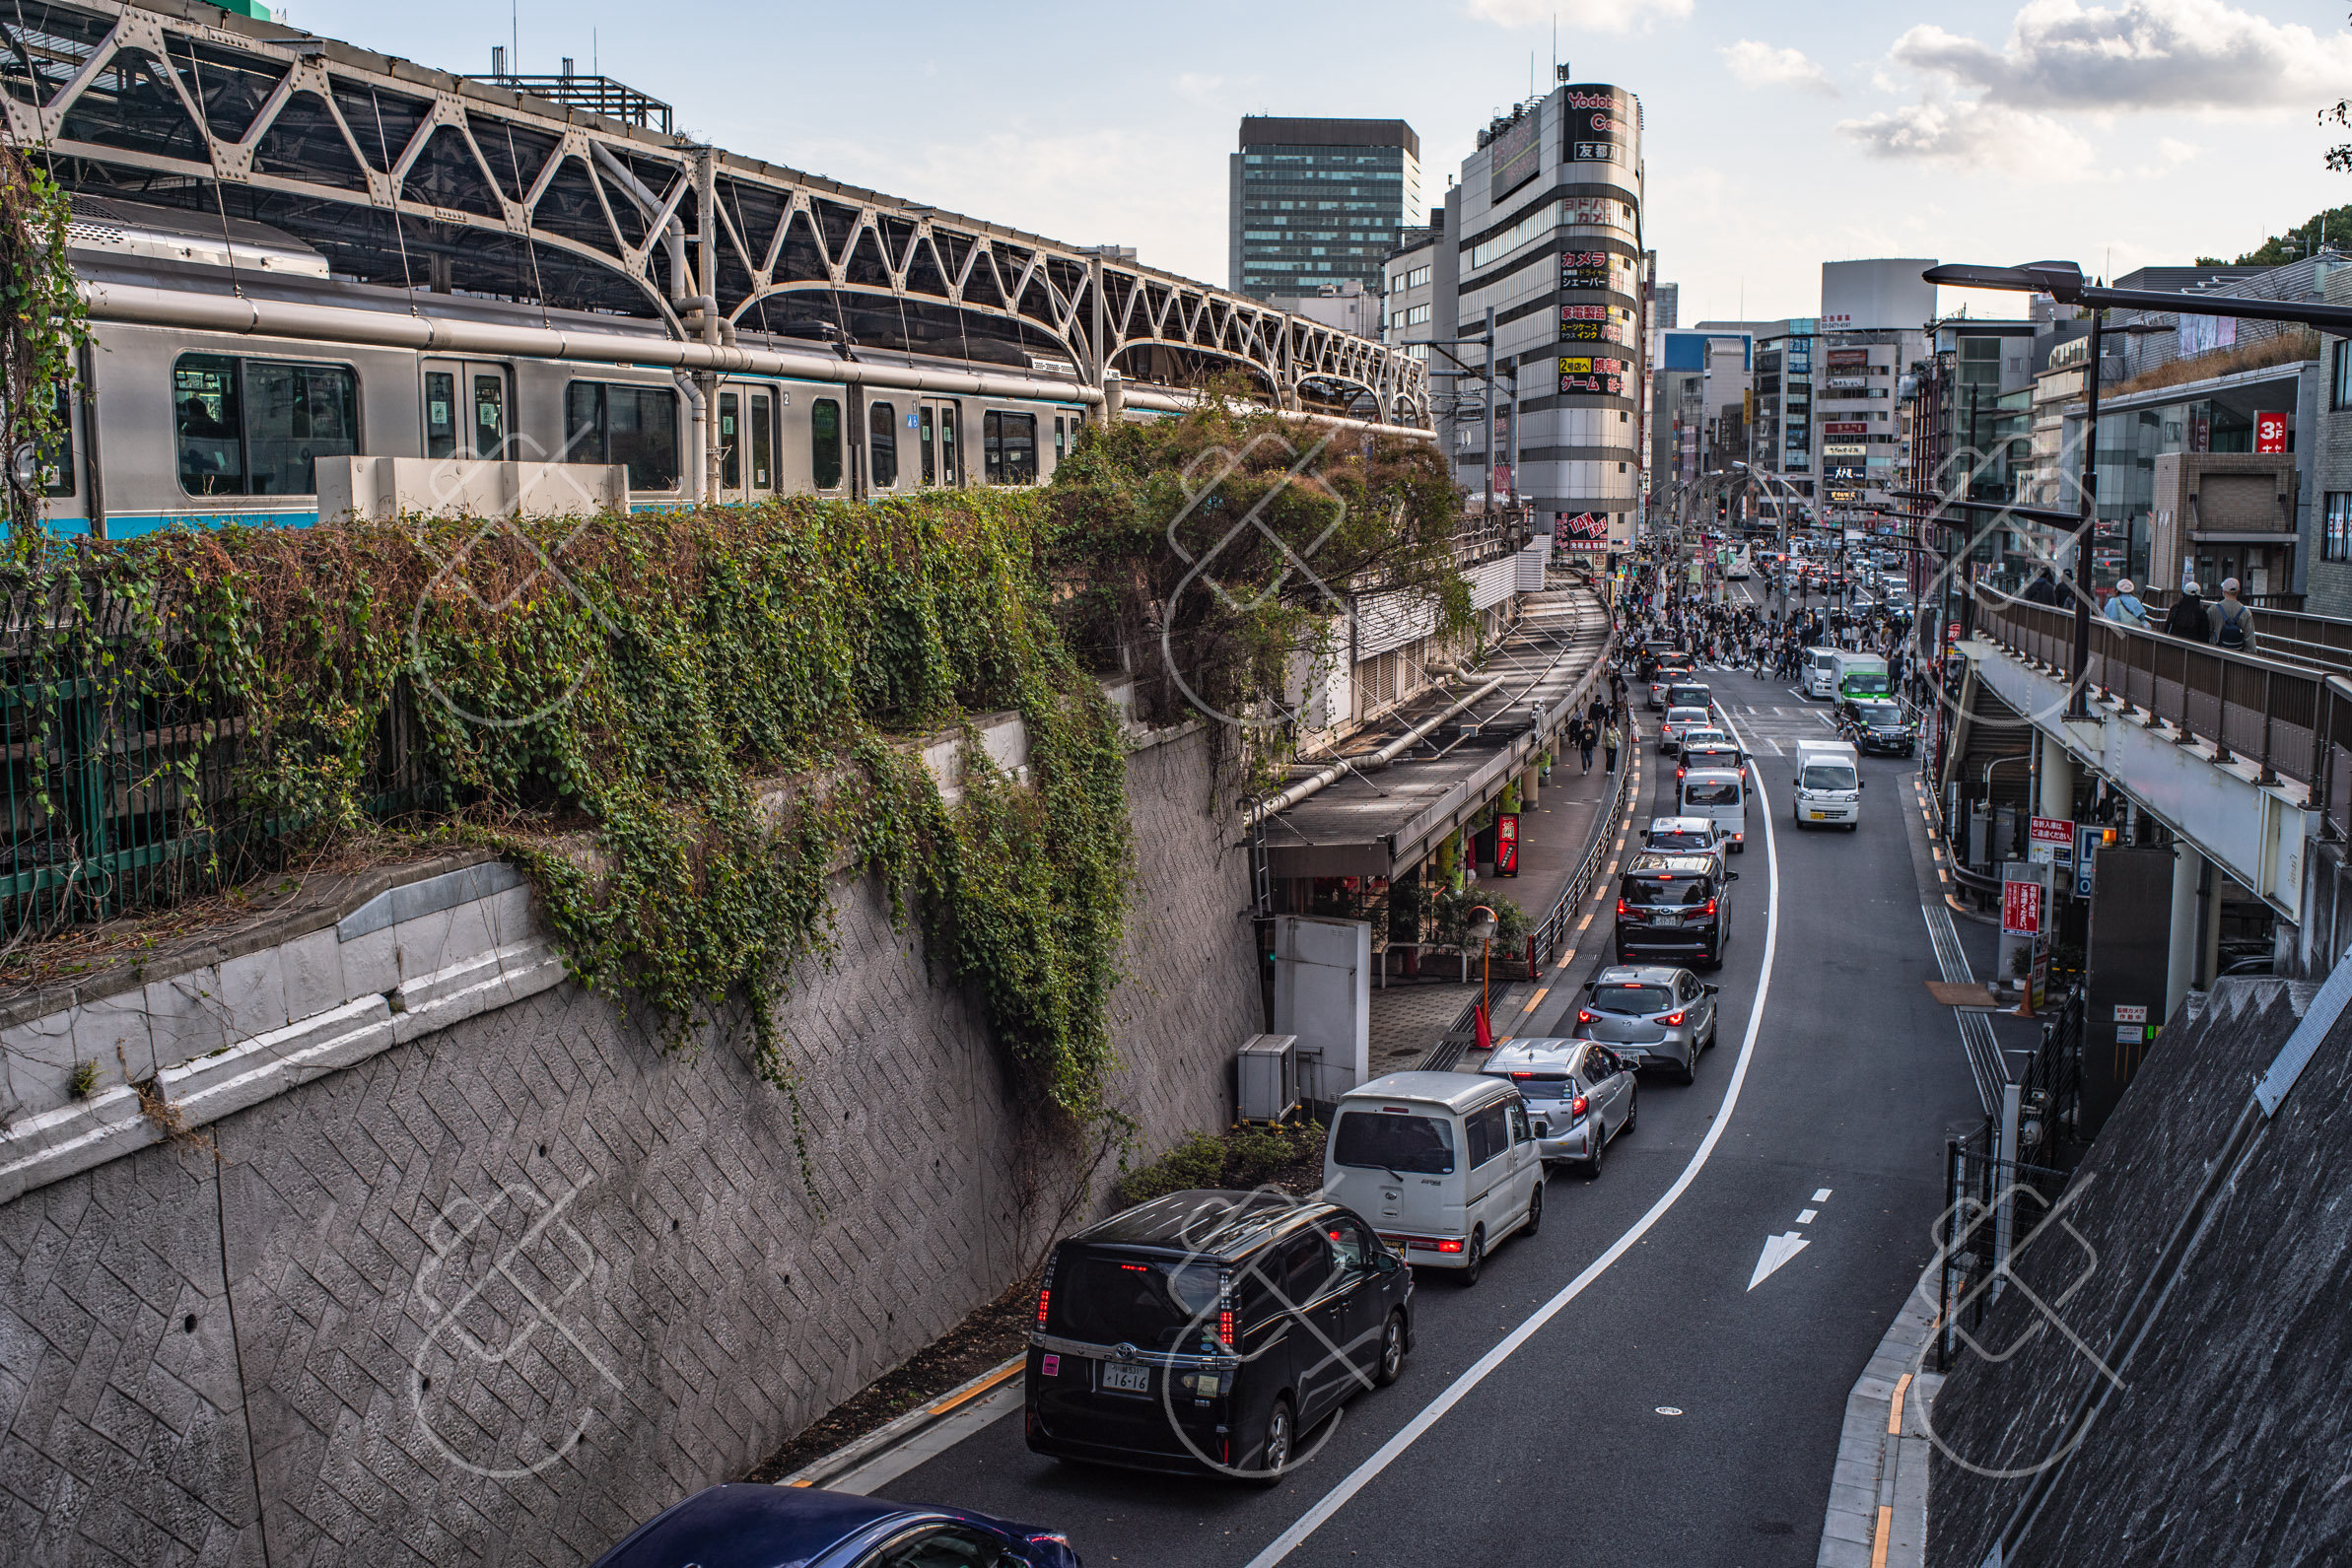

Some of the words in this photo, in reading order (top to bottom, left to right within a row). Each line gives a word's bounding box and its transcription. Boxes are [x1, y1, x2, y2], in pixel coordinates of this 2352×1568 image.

[1561, 252, 1605, 267] カメラ
[1562, 277, 1606, 287] シェーバー
[1561, 306, 1606, 320] 家電製品
[1560, 359, 1589, 372] 2号店へ
[1561, 375, 1599, 391] ゲーム
[1568, 512, 1595, 533] TAX
[1588, 517, 1608, 539] FREE
[1115, 1373, 1146, 1389] 16-16
